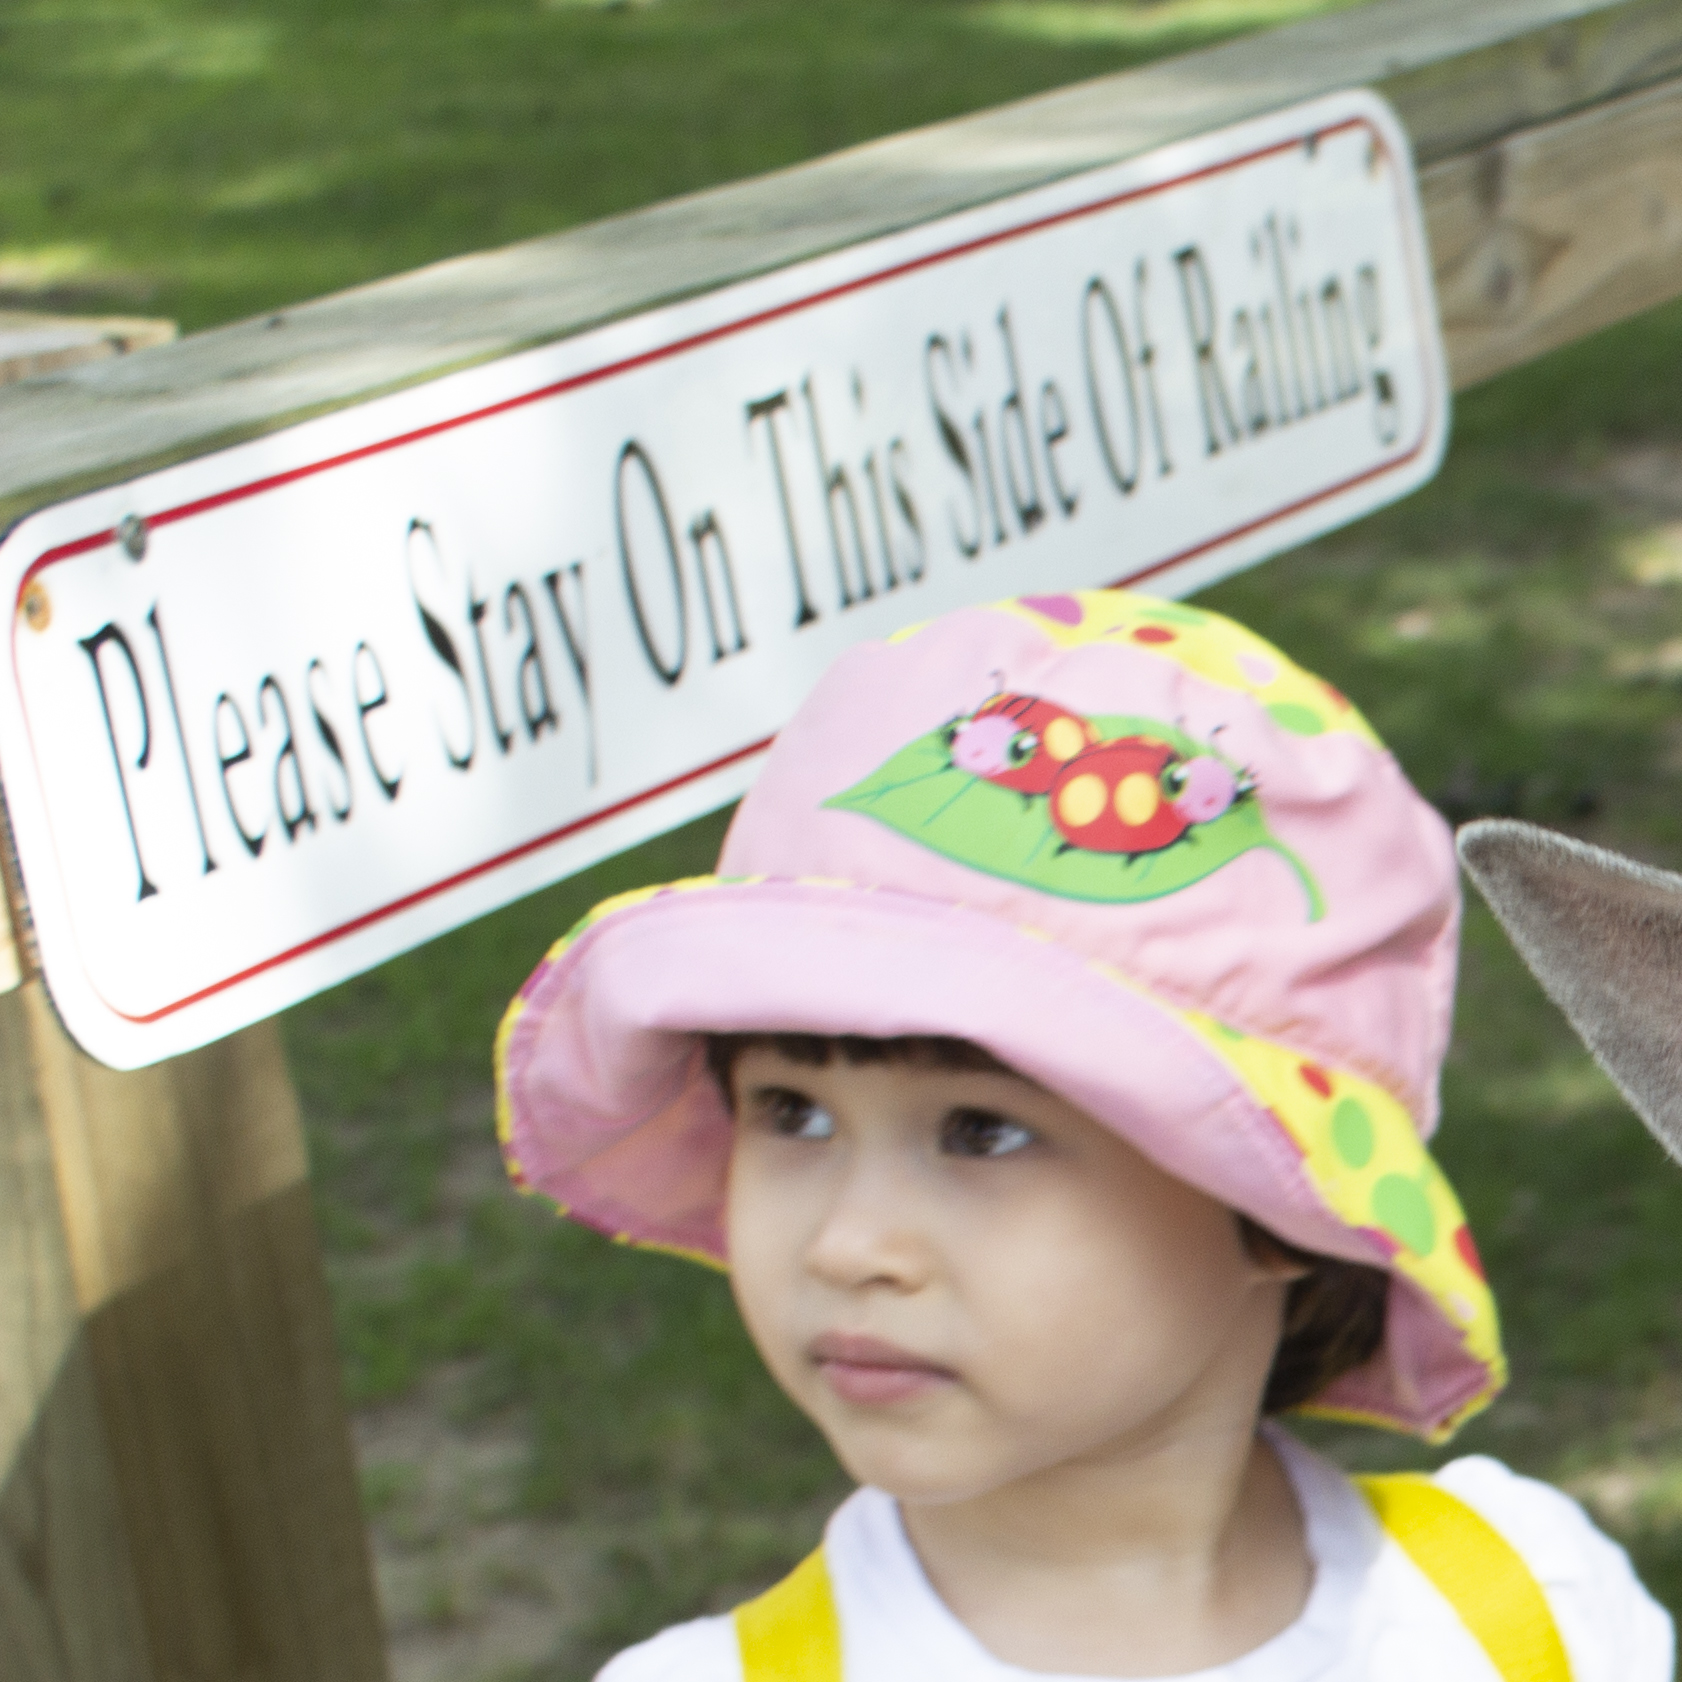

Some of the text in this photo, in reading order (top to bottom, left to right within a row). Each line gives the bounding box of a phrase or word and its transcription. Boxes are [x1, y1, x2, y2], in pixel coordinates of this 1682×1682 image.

[76, 208, 1397, 903] Please Stay On This Side Of Railing
